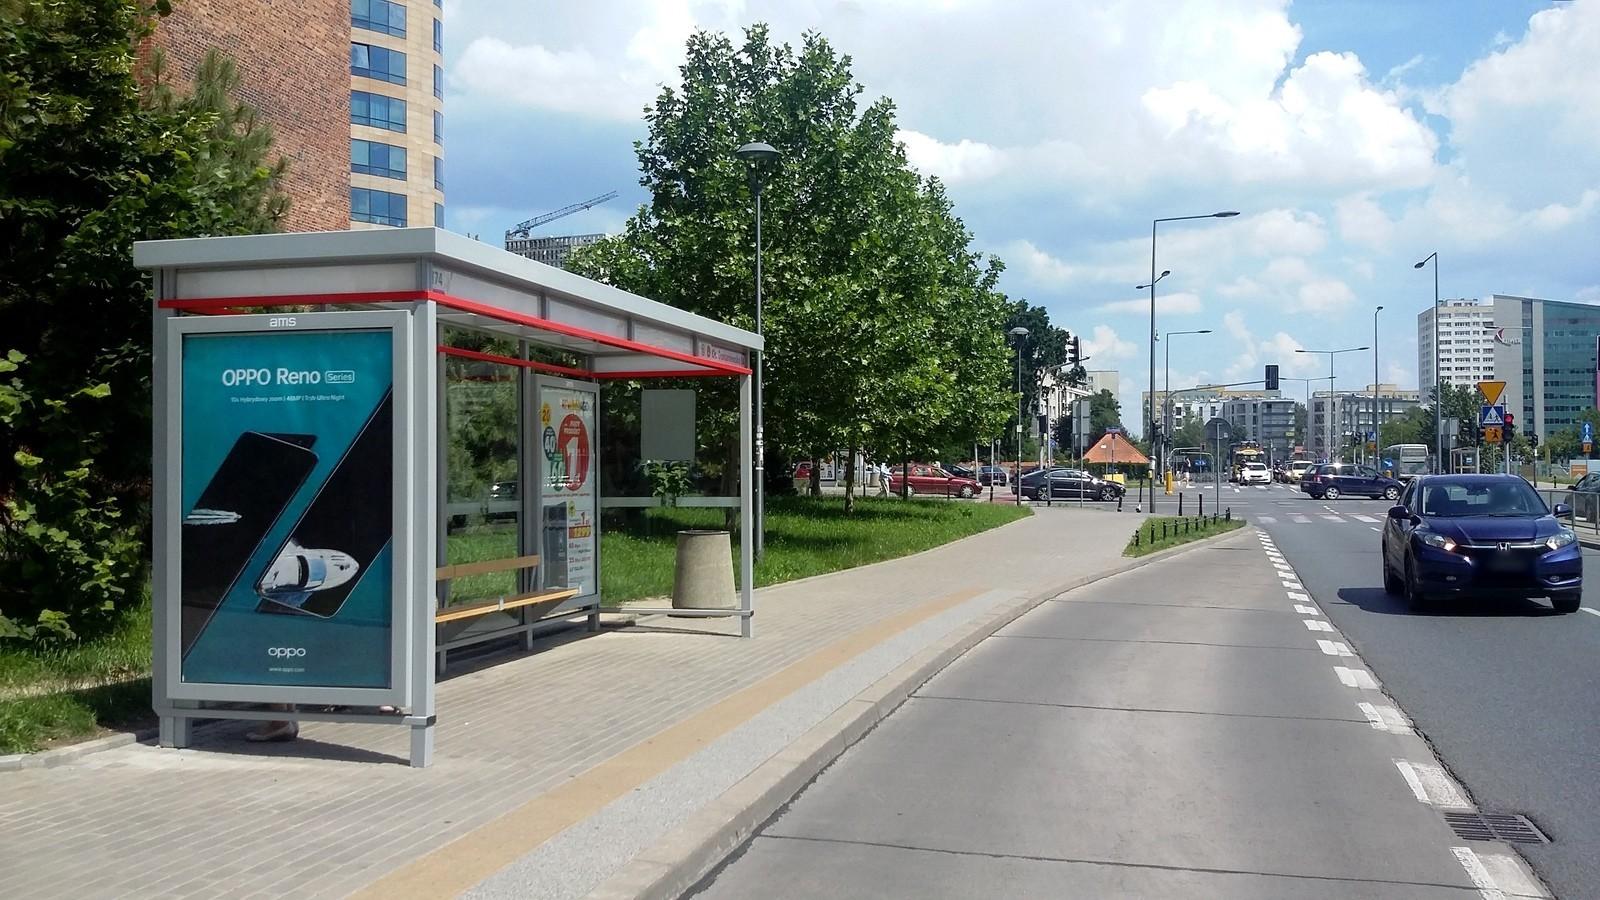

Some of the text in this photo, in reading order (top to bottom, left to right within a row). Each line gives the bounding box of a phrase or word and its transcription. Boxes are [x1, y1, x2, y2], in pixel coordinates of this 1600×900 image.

[269, 317, 297, 327] ams
[222, 367, 353, 386] OPPO Reno Series
[268, 647, 306, 659] oppo
